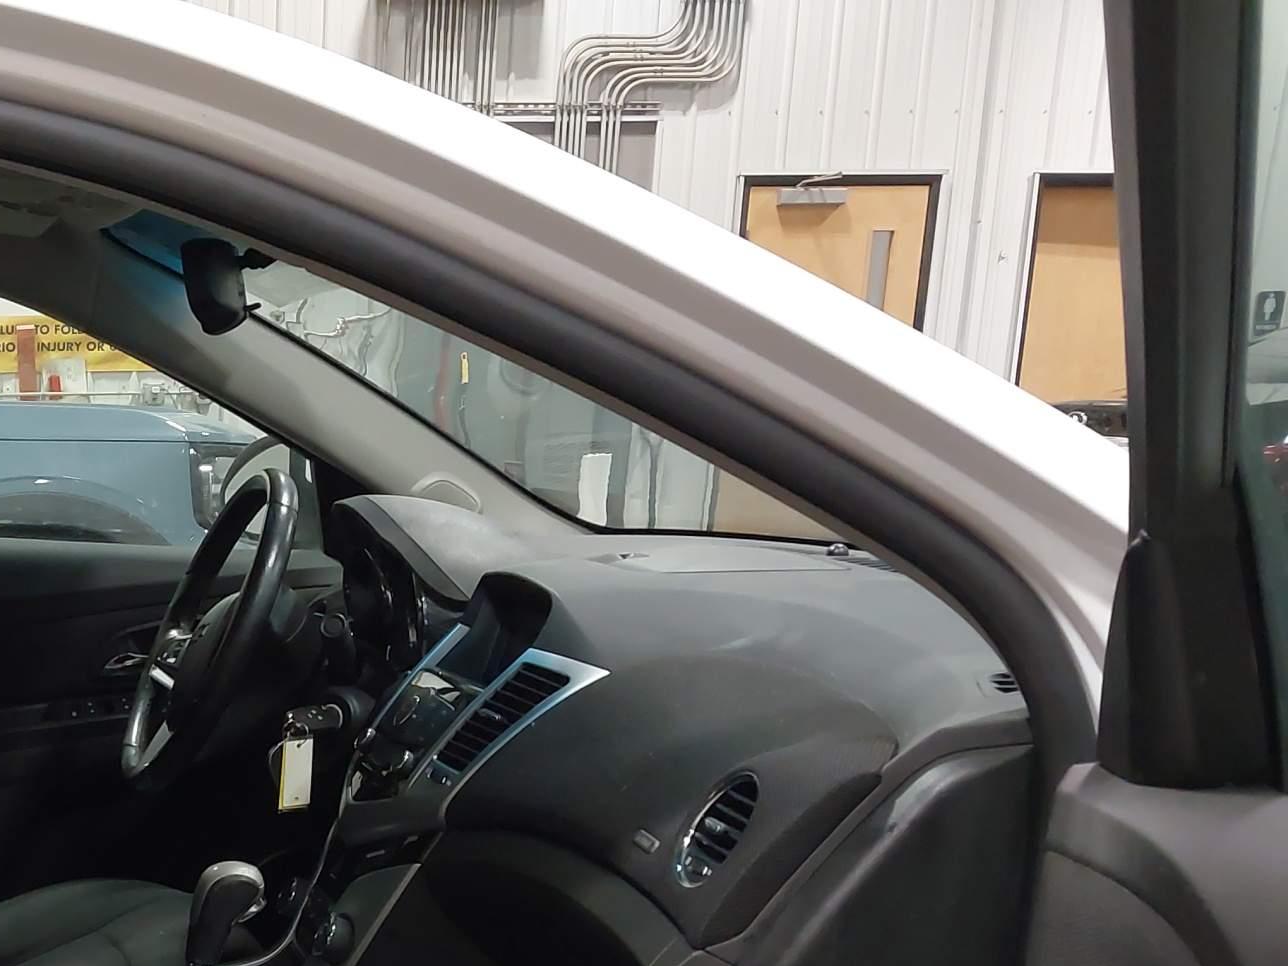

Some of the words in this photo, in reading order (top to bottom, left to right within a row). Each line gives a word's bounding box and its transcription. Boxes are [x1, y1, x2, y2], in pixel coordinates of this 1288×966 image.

[35, 324, 50, 335] TO
[36, 341, 82, 352] INJURY
[86, 341, 105, 351] OR
